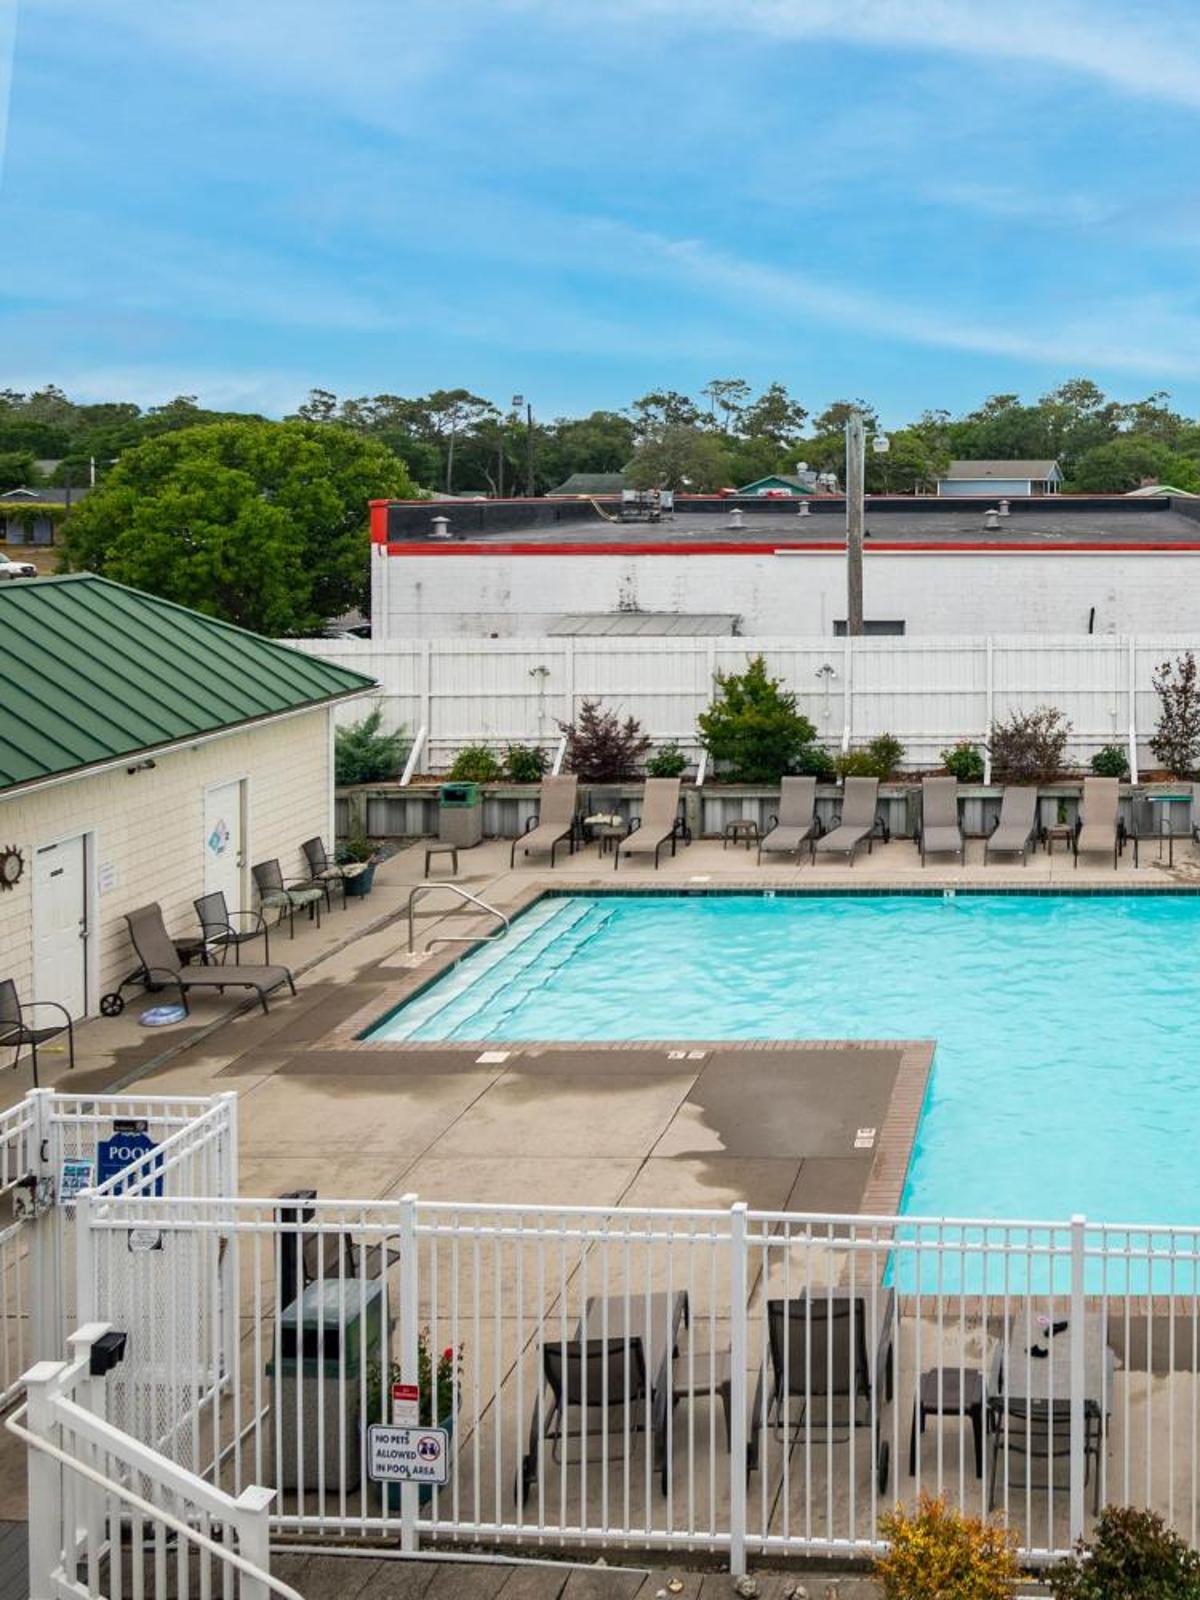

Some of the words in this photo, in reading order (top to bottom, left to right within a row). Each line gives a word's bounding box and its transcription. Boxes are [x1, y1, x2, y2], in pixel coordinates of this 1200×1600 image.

[109, 1146, 150, 1160] POO
[376, 1434, 389, 1443] NO
[390, 1436, 409, 1444] PETS
[376, 1449, 417, 1459] ALLOWED
[376, 1464, 385, 1472] IN
[387, 1464, 409, 1473] POOL
[413, 1466, 435, 1474] AREA
